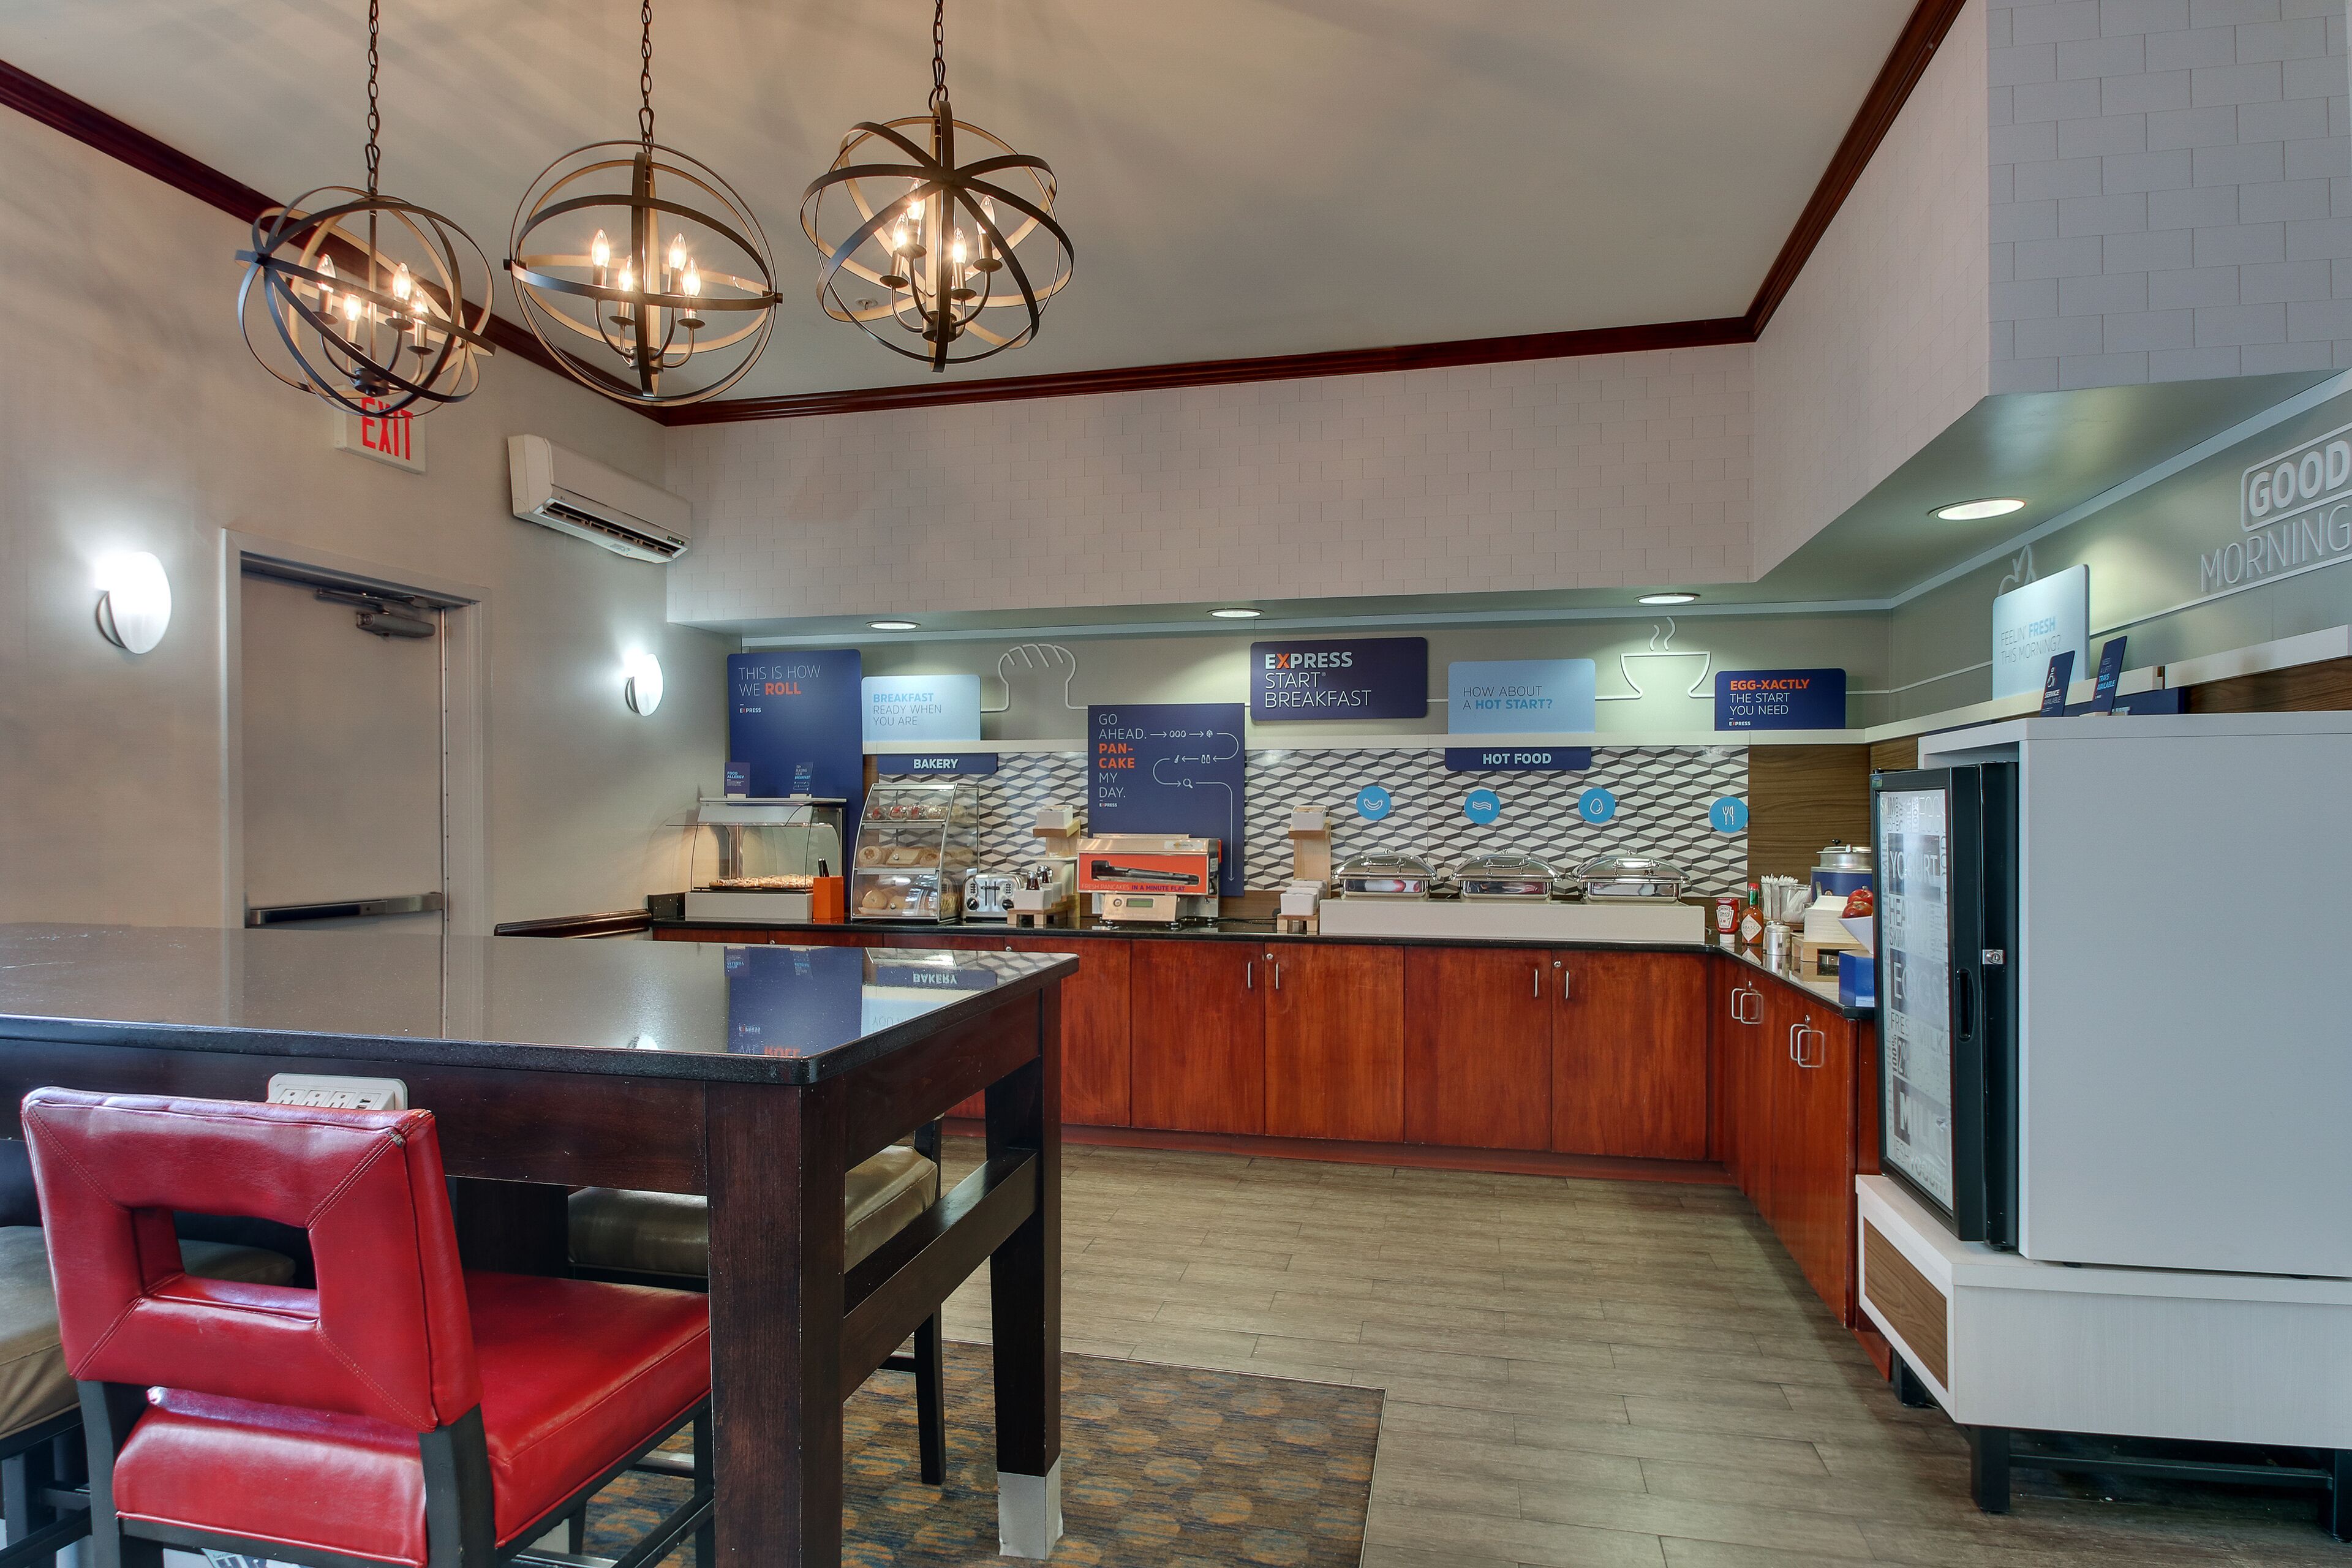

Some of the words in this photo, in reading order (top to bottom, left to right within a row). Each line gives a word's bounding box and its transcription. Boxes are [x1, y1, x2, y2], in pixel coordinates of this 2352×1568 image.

[361, 397, 413, 461] EXIT
[2248, 440, 2350, 518] GOOD
[2201, 504, 2351, 592] MORNING
[2029, 616, 2056, 638] FRESH
[2001, 647, 2016, 665] THIS
[2019, 635, 2061, 661] MORNING?
[1265, 652, 1353, 669] EXPRESS
[738, 666, 767, 680] THIS
[771, 666, 782, 679] IS
[787, 665, 821, 679] HOW
[739, 683, 760, 696] WE
[765, 682, 802, 696] ROLL
[1730, 679, 1810, 690] EGG-XACTLY
[1463, 687, 1494, 697] HOW
[1499, 685, 1542, 696] ABOUT
[2045, 688, 2060, 698] SERVICE
[873, 693, 934, 703] BREAKFAST
[1265, 690, 1372, 707] BREAKFAST
[1730, 693, 1752, 703] THE
[1755, 692, 1790, 703] START
[873, 705, 907, 714] READY
[910, 704, 941, 714] WHEN
[1463, 700, 1472, 710] A
[1476, 699, 1501, 709] HOT
[1506, 699, 1553, 709] START?
[1729, 706, 1754, 715] YOU
[1758, 705, 1789, 715] NEED
[873, 717, 894, 726] YOU
[897, 716, 918, 726] ARE
[1099, 714, 1117, 725] GO
[1099, 728, 1147, 739] AHEAD.
[1099, 743, 1134, 754] PAN-
[913, 758, 959, 769] BAKERY
[1099, 758, 1135, 769] CAKE
[1483, 753, 1510, 764] HOT
[1514, 753, 1551, 764] FOOD
[1099, 772, 1118, 783] MY
[1099, 787, 1126, 797] DAY.
[1889, 927, 1905, 949] SKIM
